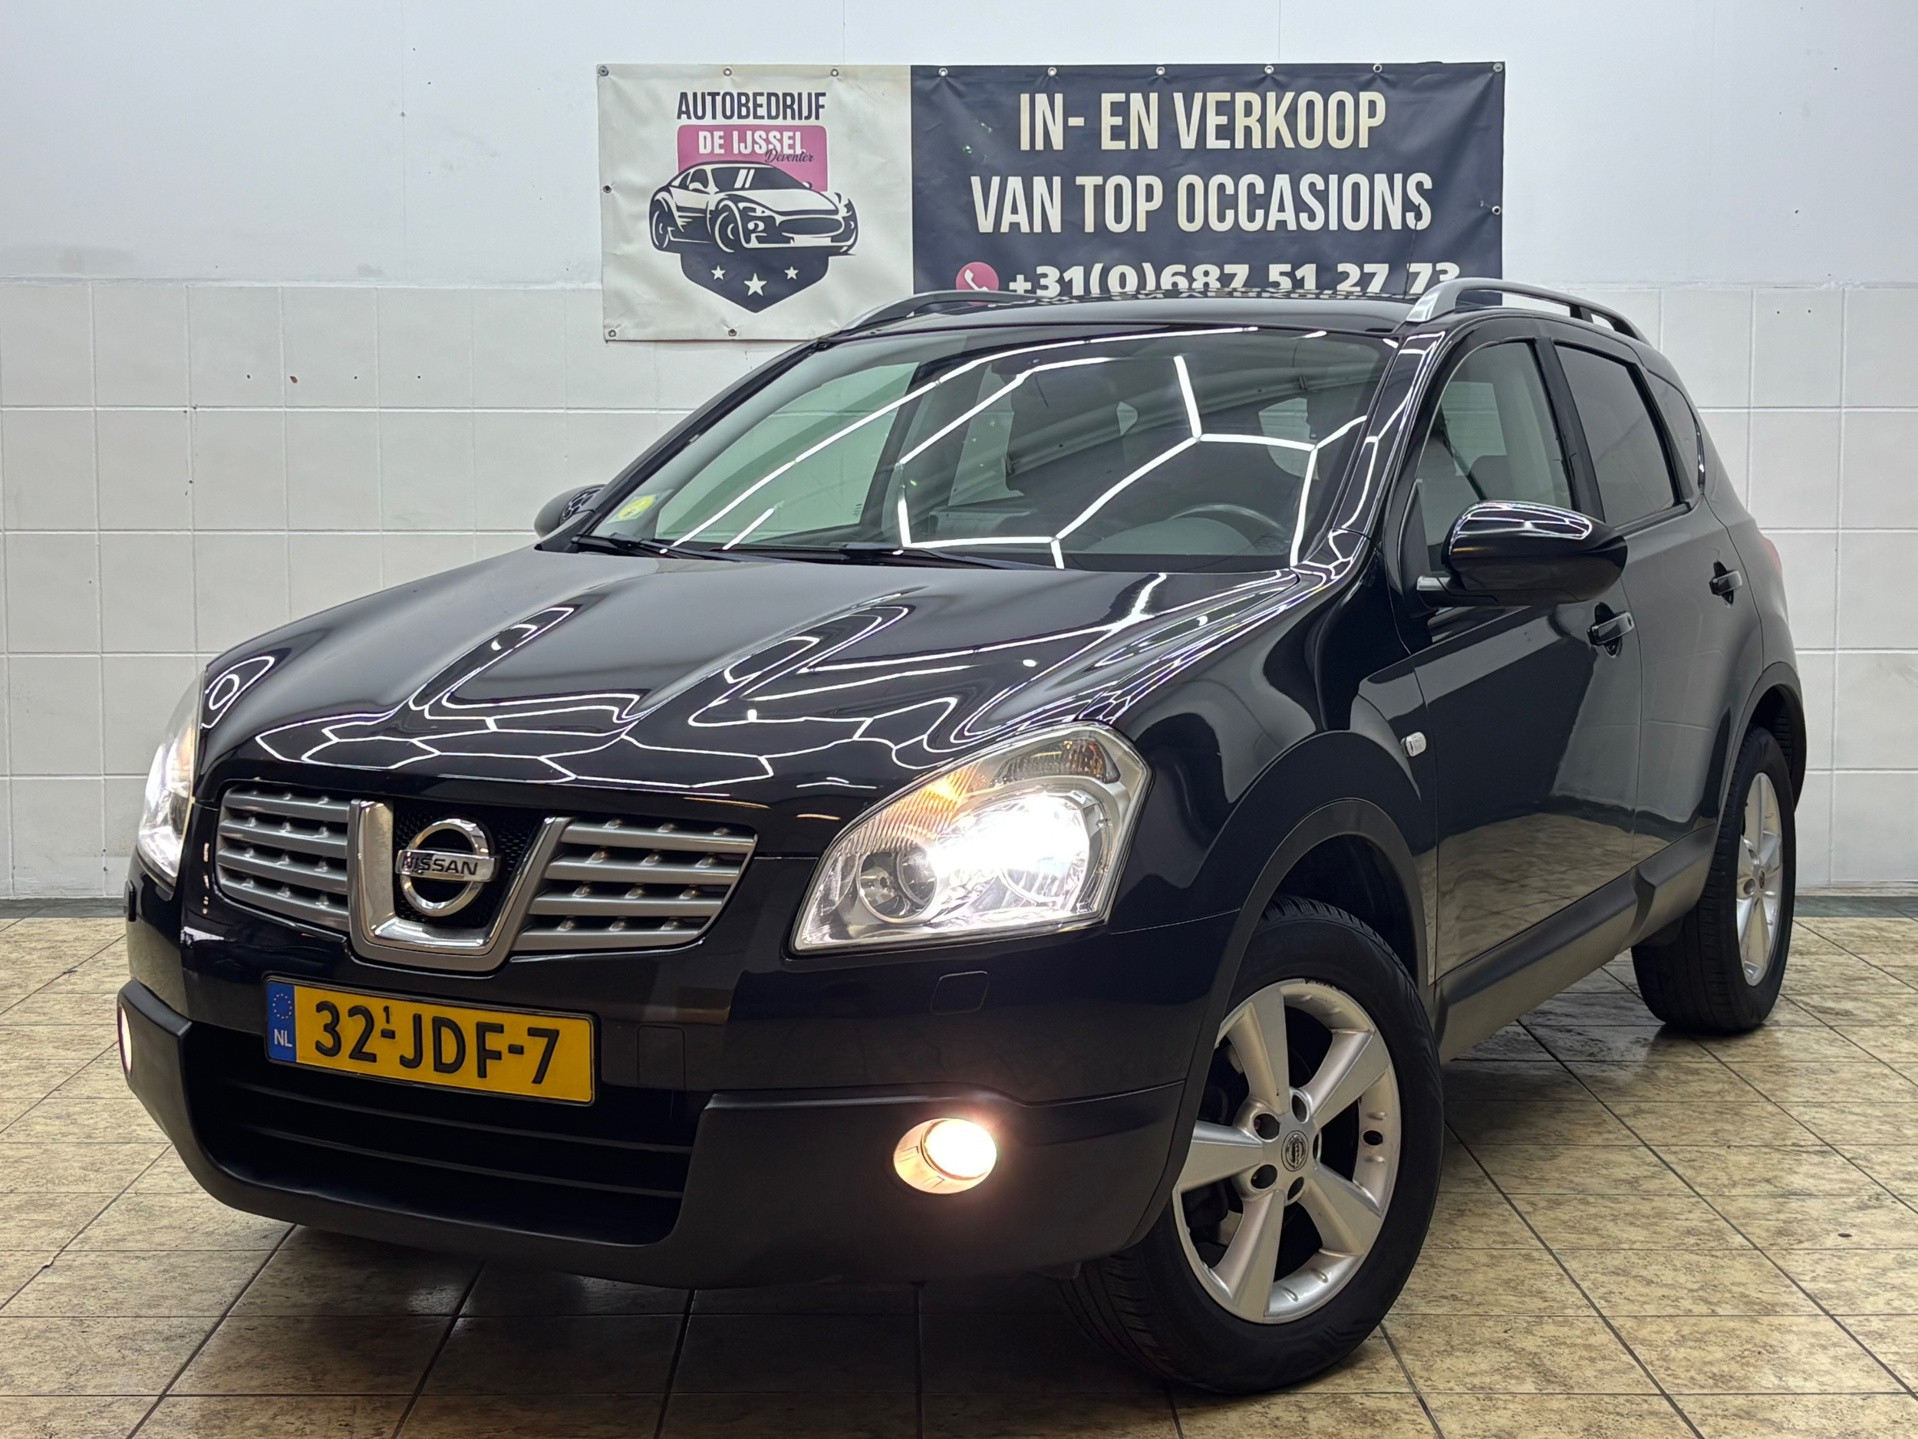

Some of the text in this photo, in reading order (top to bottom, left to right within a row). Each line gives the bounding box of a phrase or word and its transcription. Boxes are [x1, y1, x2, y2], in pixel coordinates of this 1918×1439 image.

[676, 91, 827, 120] AUTOBEDRIJF
[1020, 90, 1387, 151] IN- EN VERKOOP
[698, 130, 807, 155] DE IJSSEL
[970, 172, 1432, 234] VAN TOP OCCASIONS
[1268, 263, 1317, 290] 51
[1337, 262, 1390, 292] 27
[401, 855, 479, 875] NISSAN
[273, 1028, 293, 1048] NL
